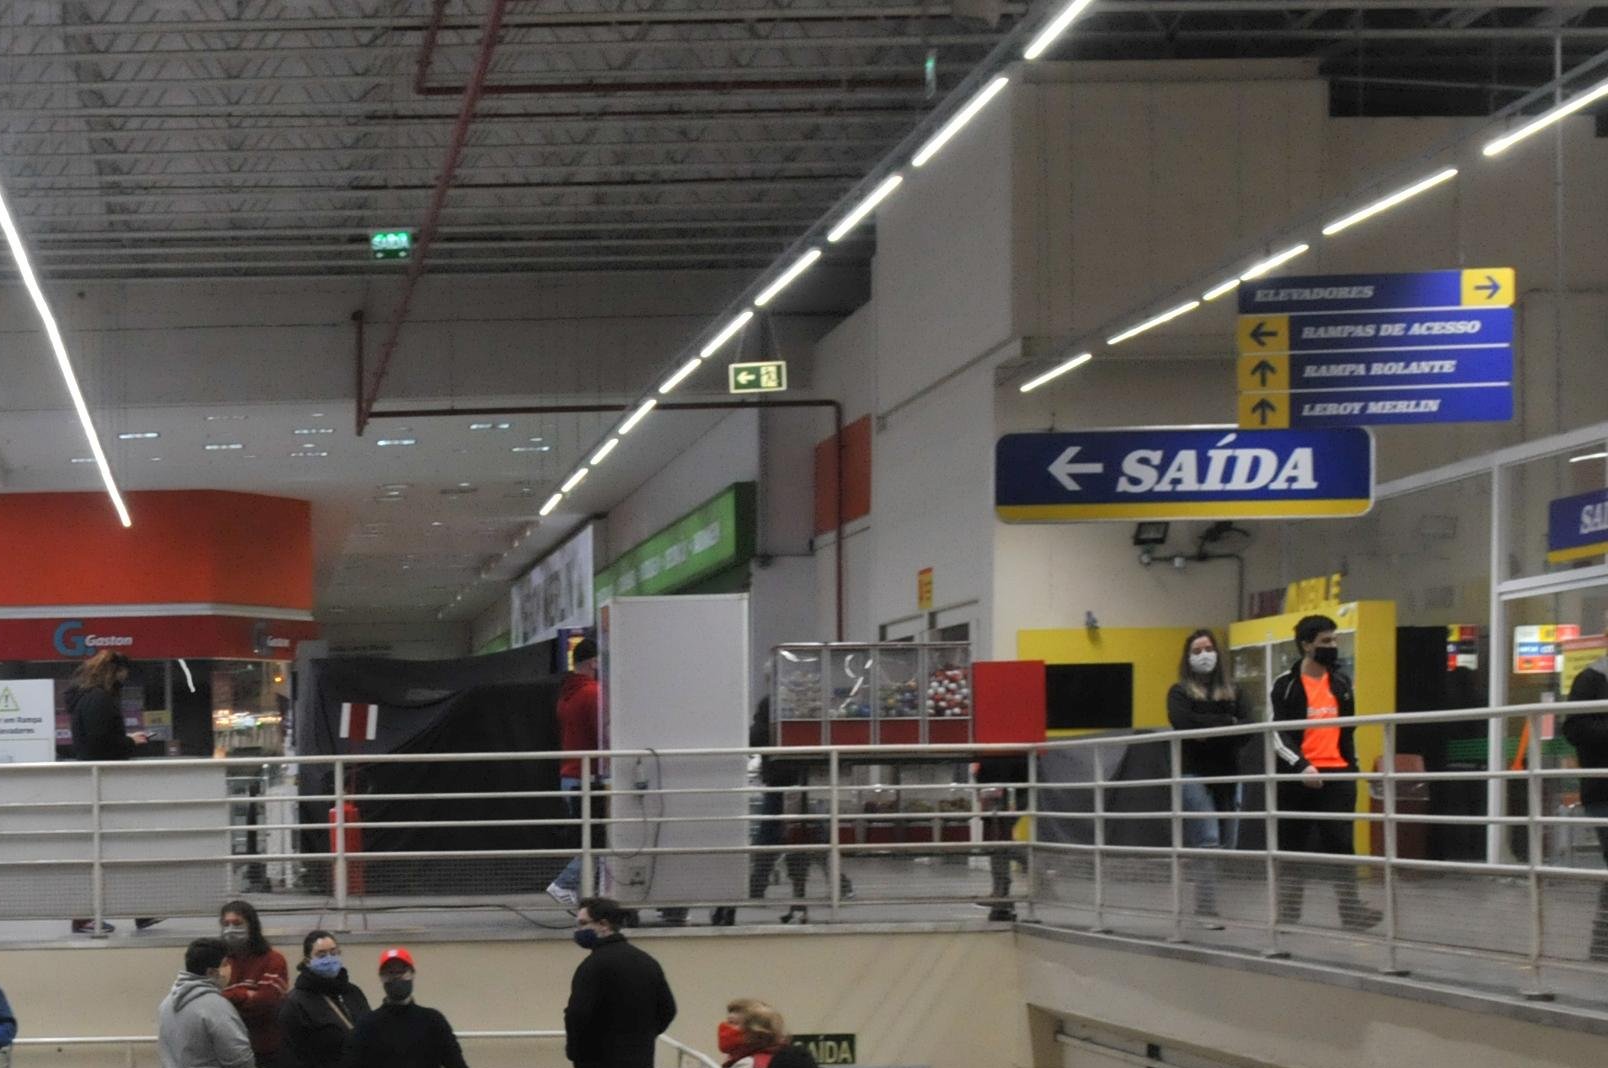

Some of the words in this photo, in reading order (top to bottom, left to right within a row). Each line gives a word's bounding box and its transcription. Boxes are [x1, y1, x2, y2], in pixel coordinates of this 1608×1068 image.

[1254, 285, 1375, 302] ELEVADORES
[1301, 323, 1376, 339] RAMPAS
[1378, 322, 1407, 337] DE
[1407, 320, 1482, 336] ACESSO
[1302, 363, 1367, 378] RAMPA
[1369, 360, 1458, 375] ROLANTE
[1301, 402, 1365, 416] LEROY
[1366, 399, 1442, 415] MERLIN
[1115, 432, 1319, 493] SAÍDA
[85, 634, 133, 647] Gaston
